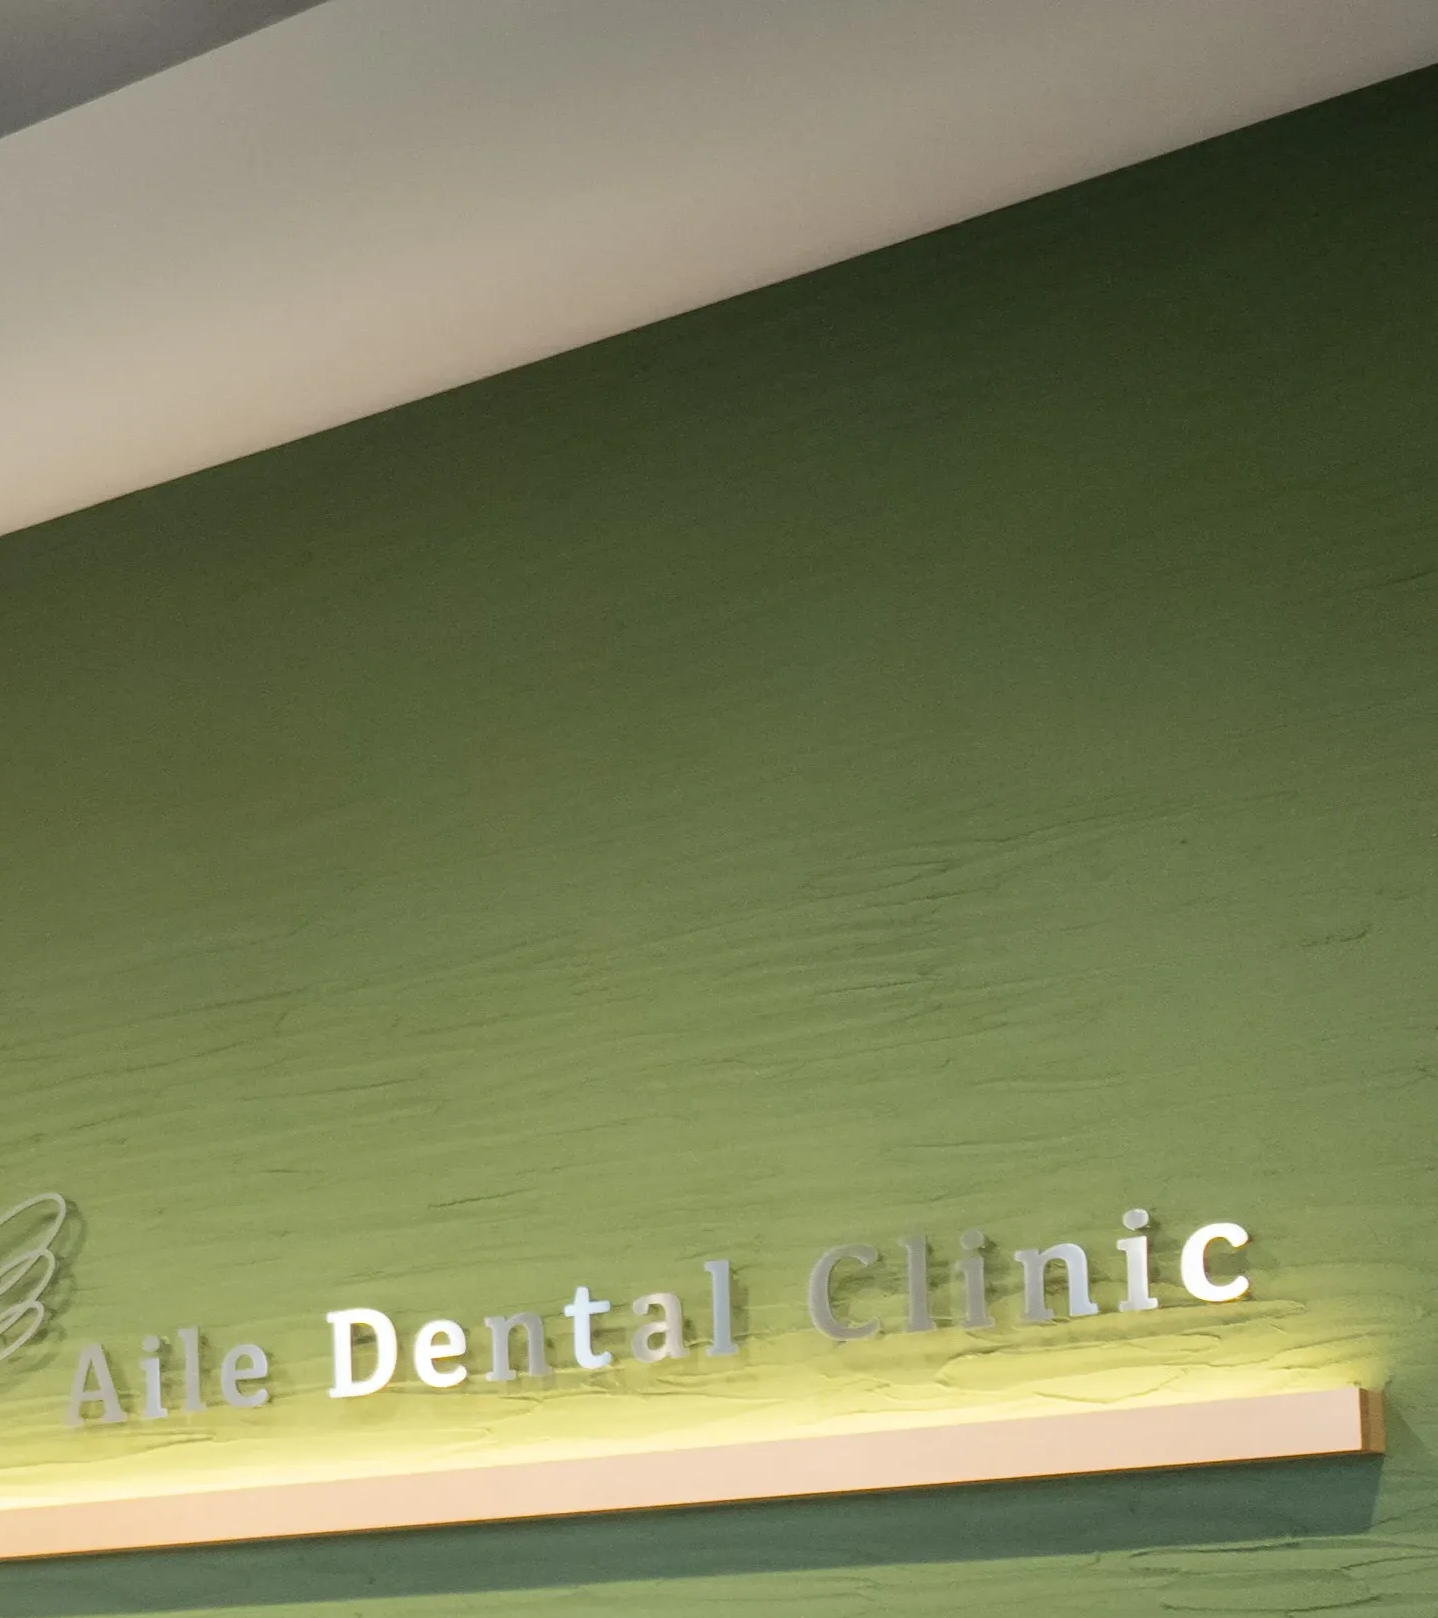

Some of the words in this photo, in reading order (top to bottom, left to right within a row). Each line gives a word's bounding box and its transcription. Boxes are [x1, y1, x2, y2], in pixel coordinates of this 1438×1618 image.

[61, 1324, 268, 1427] Aile
[326, 1260, 739, 1399] Dental
[808, 1208, 1250, 1341] Clinic
